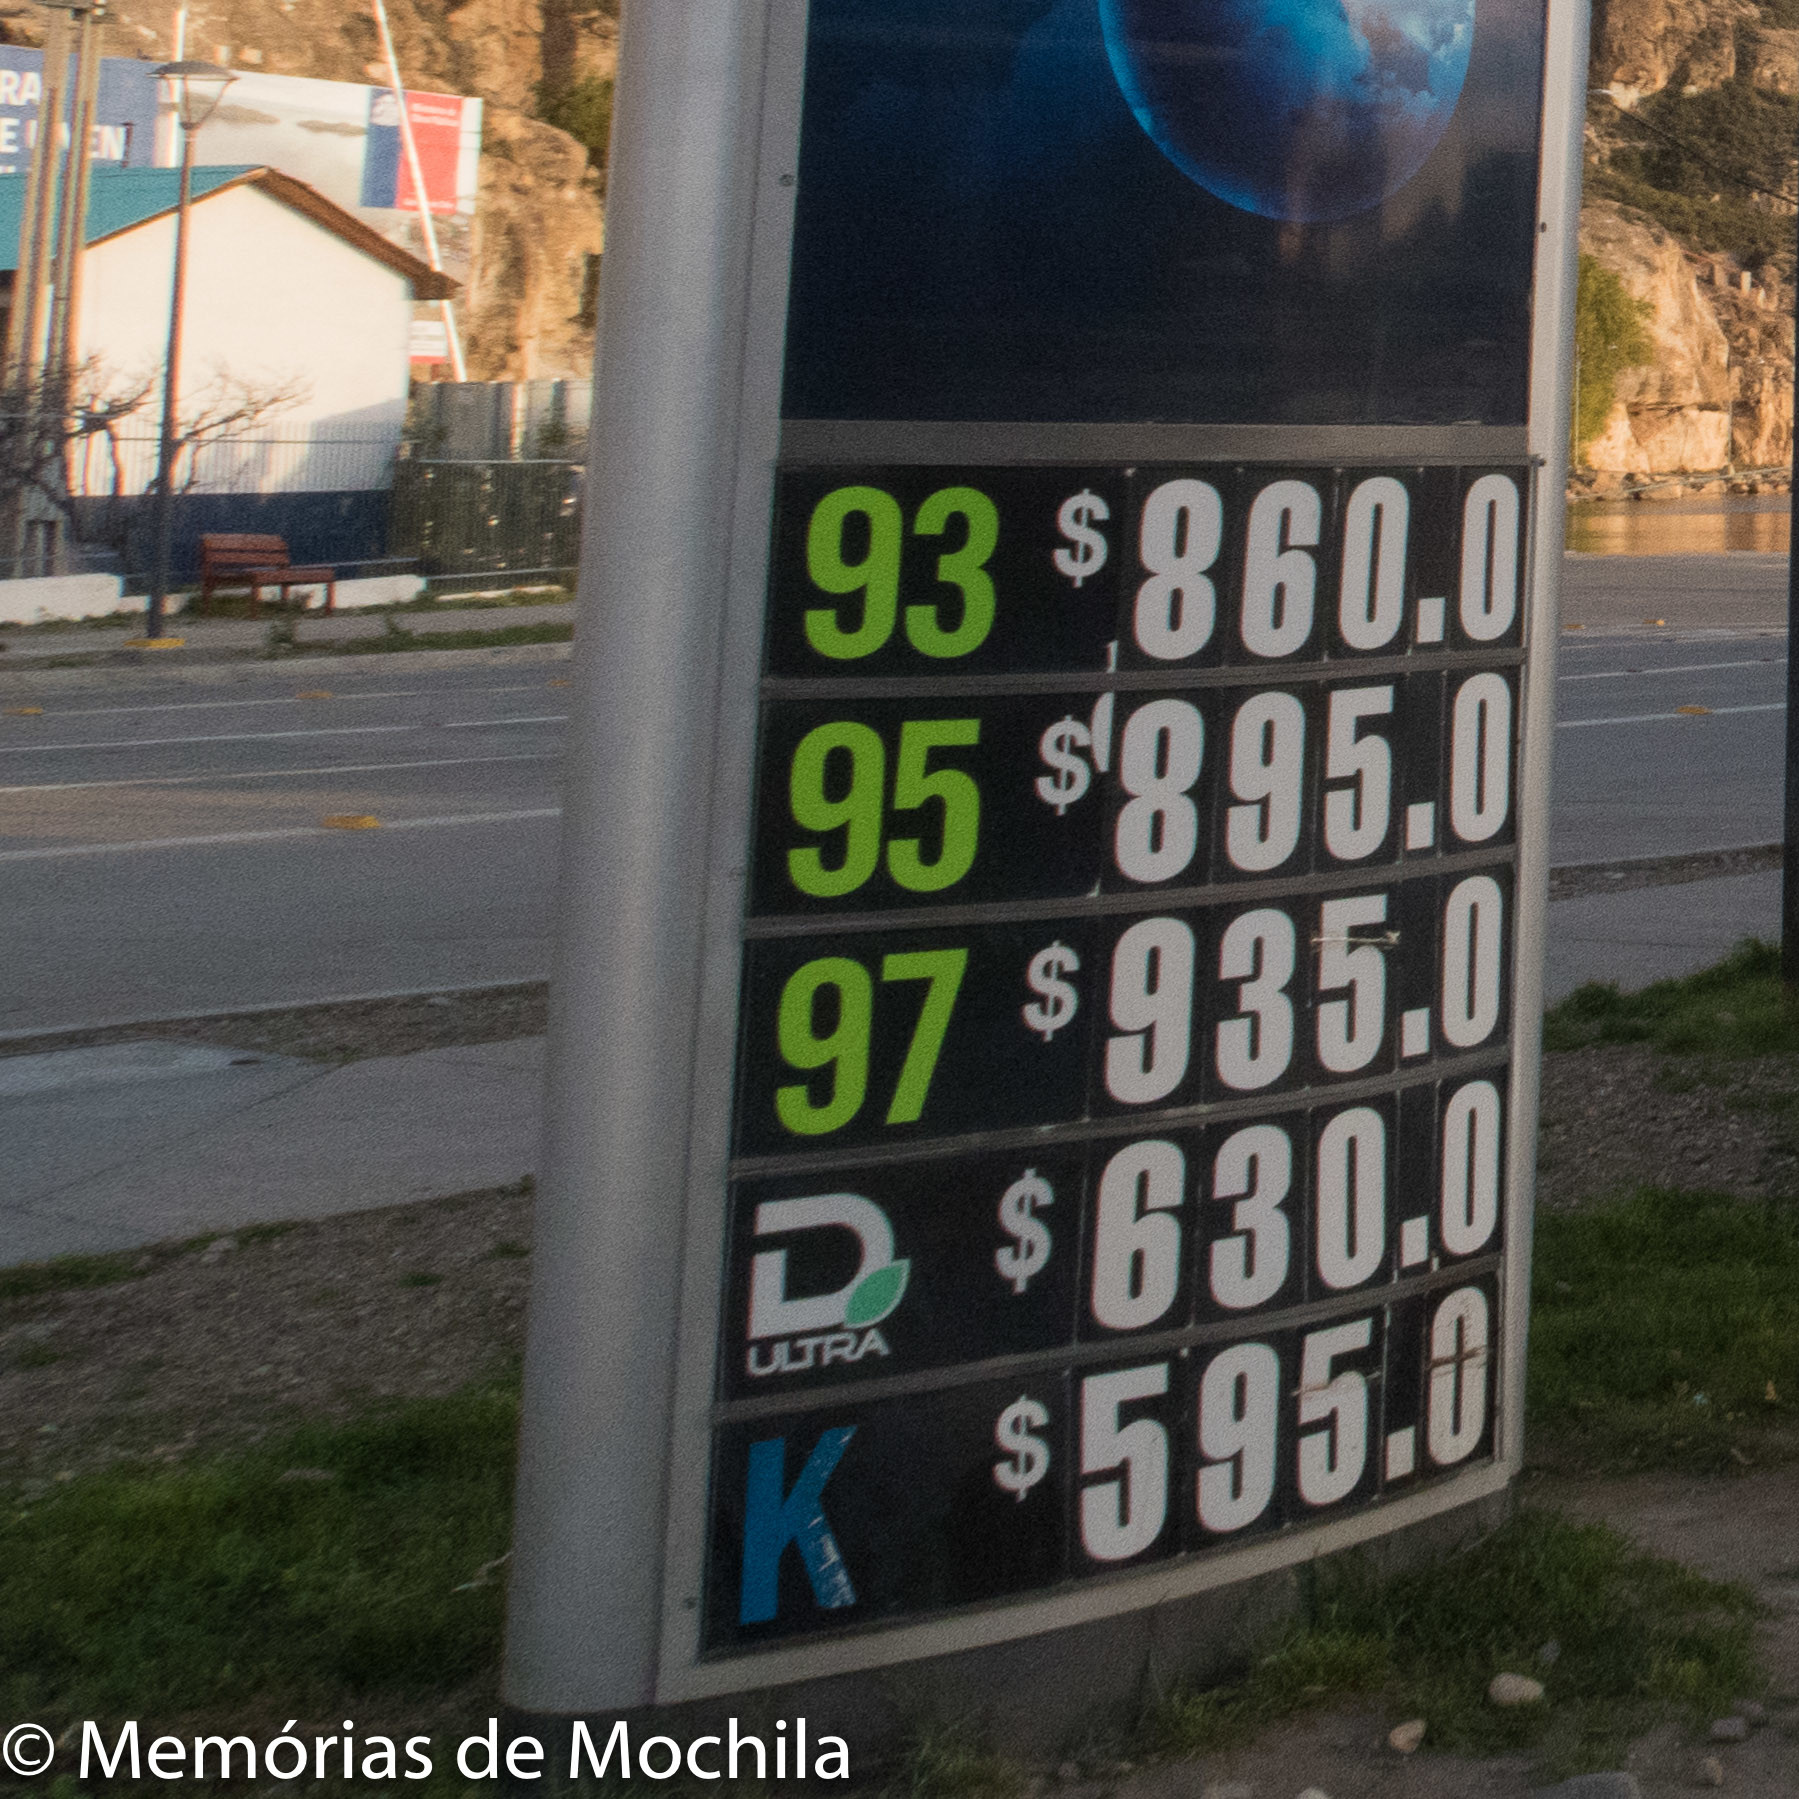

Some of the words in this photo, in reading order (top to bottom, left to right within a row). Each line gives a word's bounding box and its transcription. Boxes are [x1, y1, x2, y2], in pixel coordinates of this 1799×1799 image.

[805, 486, 1000, 660] 93
[787, 718, 982, 898] 95
[775, 947, 969, 1136] 97
[748, 1328, 891, 1377] ULTRA
[739, 1425, 857, 1627] K
